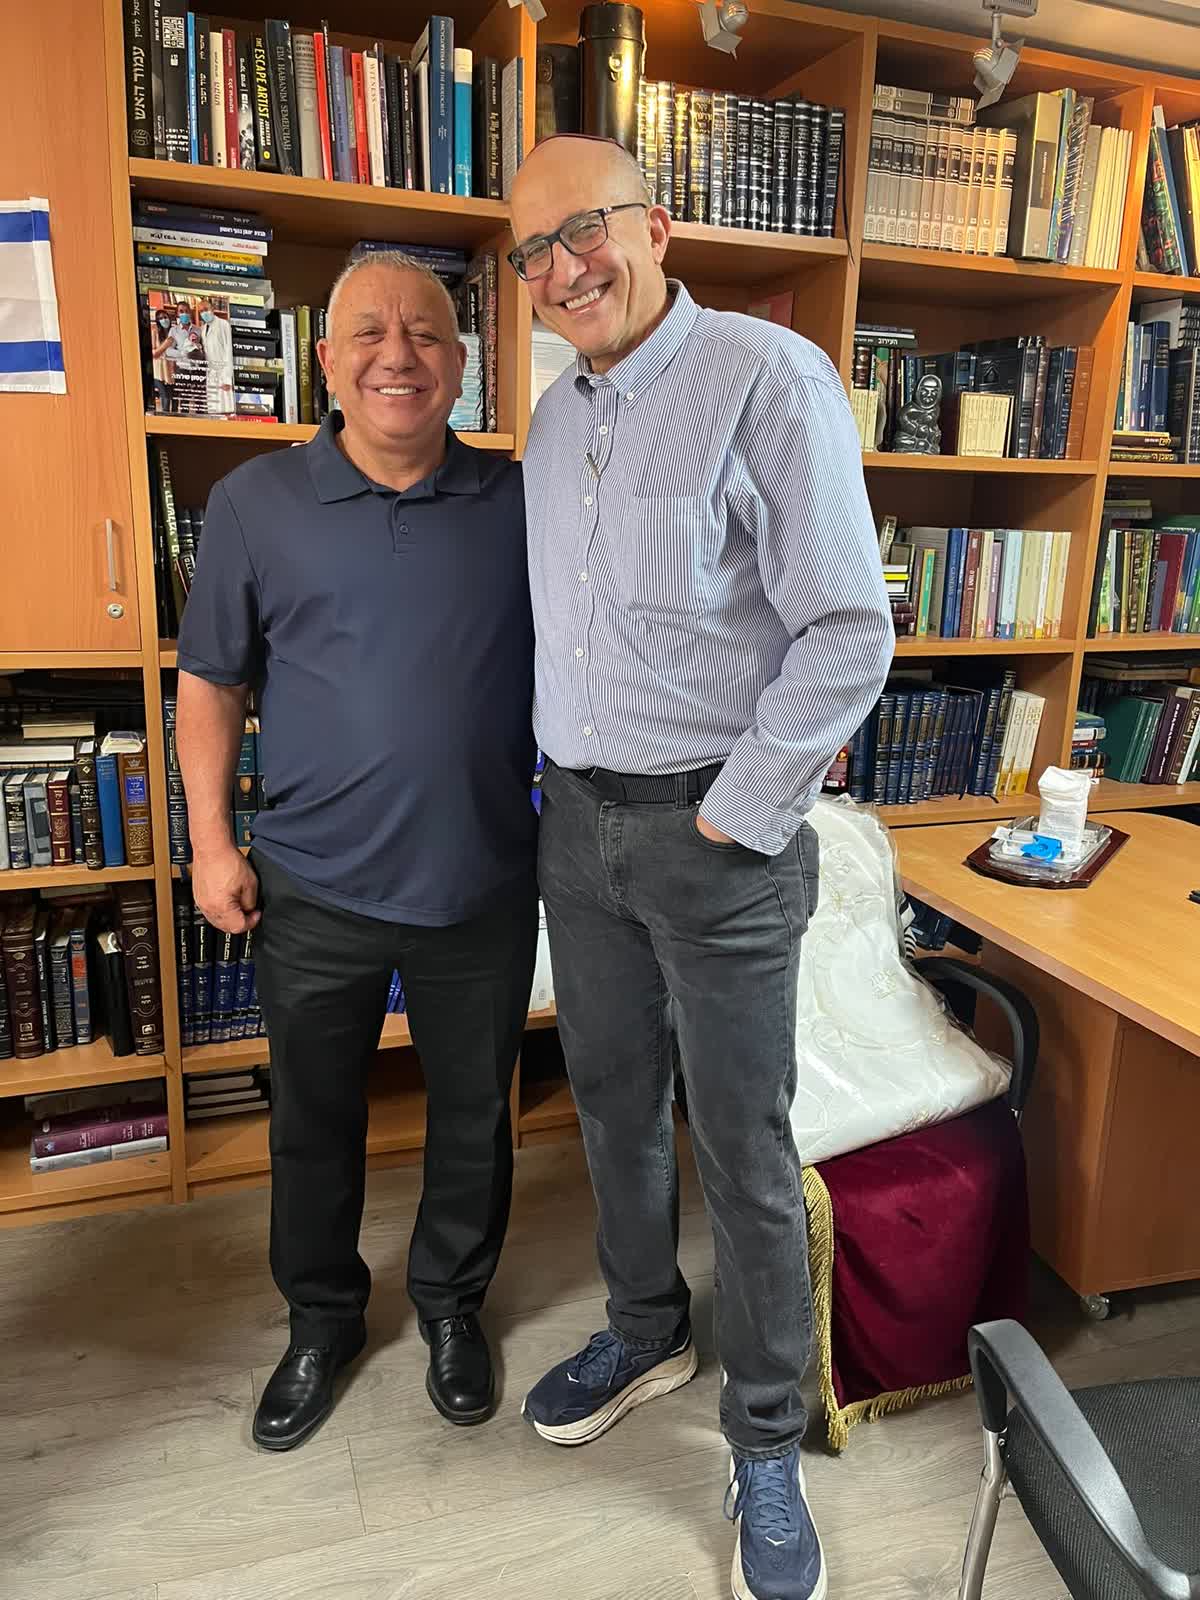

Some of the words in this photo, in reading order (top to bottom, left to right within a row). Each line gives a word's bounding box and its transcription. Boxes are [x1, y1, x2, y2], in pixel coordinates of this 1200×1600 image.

[254, 38, 263, 48] THE
[276, 46, 284, 61] EIM
[132, 46, 145, 82] עמוד
[254, 48, 267, 84] ESCAPE
[439, 62, 446, 70] OF
[278, 64, 288, 103] HABANIM
[369, 63, 377, 103] WITNESS
[134, 85, 147, 120] האש
[256, 84, 270, 119] ARTIST
[280, 105, 291, 151] SEMEICHAH
[233, 343, 253, 351] ישראלי
[300, 338, 309, 370] מכתבי
[877, 337, 898, 345] העירוב
[301, 371, 310, 386] יוני
[159, 450, 170, 487] תלמוד
[165, 490, 177, 536] ירושלמי
